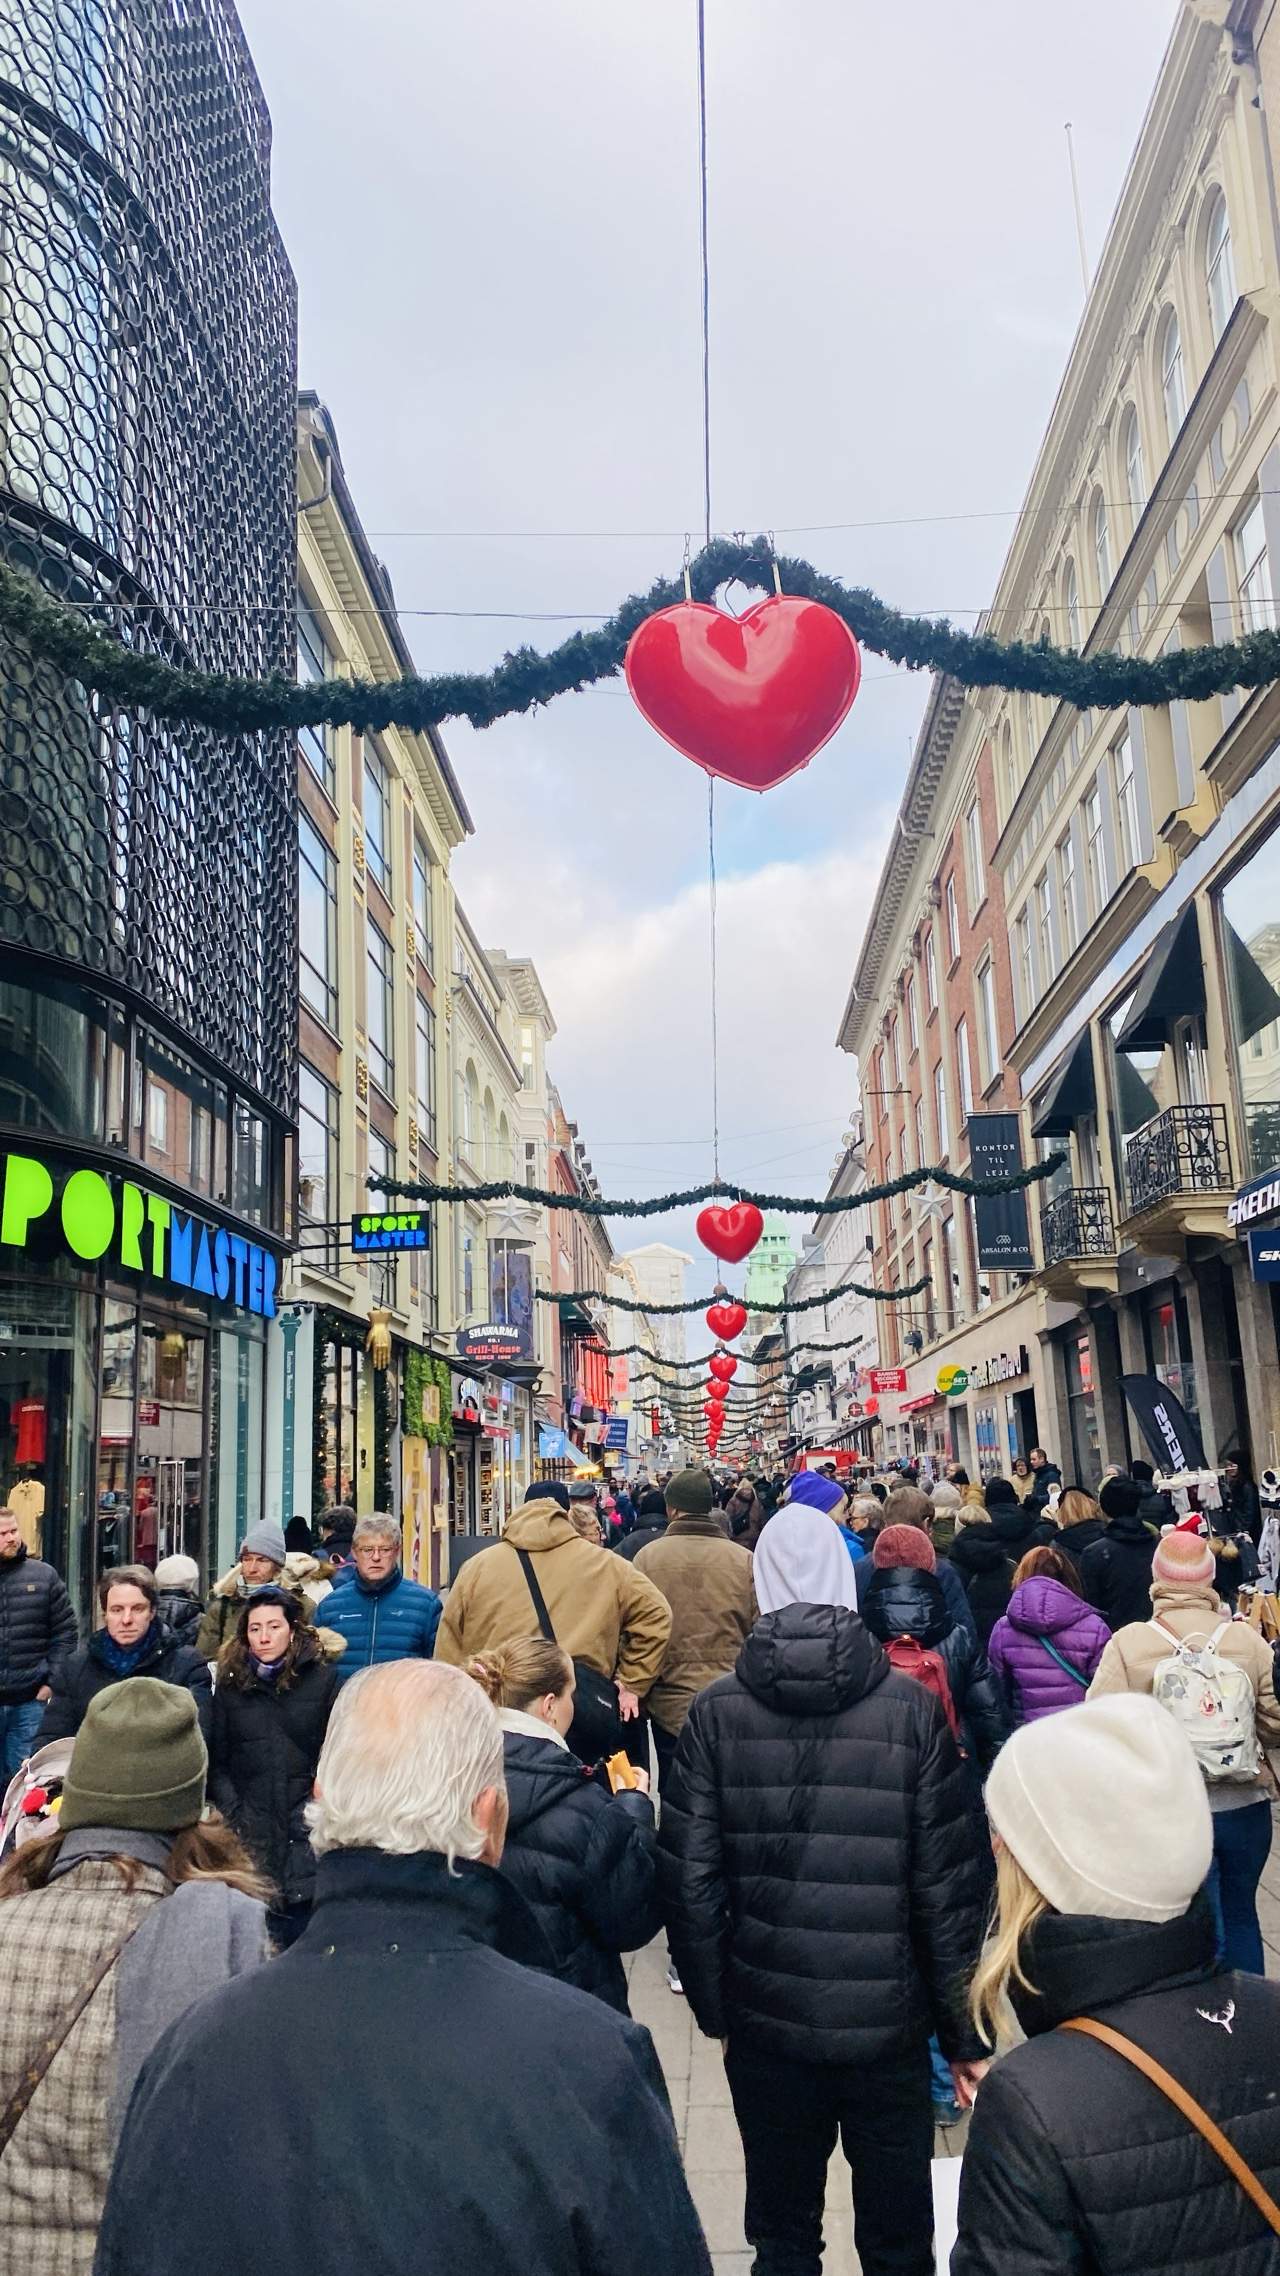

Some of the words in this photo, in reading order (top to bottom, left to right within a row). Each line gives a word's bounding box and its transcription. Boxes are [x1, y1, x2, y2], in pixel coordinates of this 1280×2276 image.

[975, 1143, 1016, 1152] KONTOR
[988, 1156, 1005, 1164] TIL
[985, 1169, 1009, 1177] LEJE
[360, 1215, 420, 1233] SPORT
[354, 1231, 426, 1249] MASTER
[980, 1246, 1011, 1254] ABSALON
[468, 1325, 519, 1339] SHAWARMA
